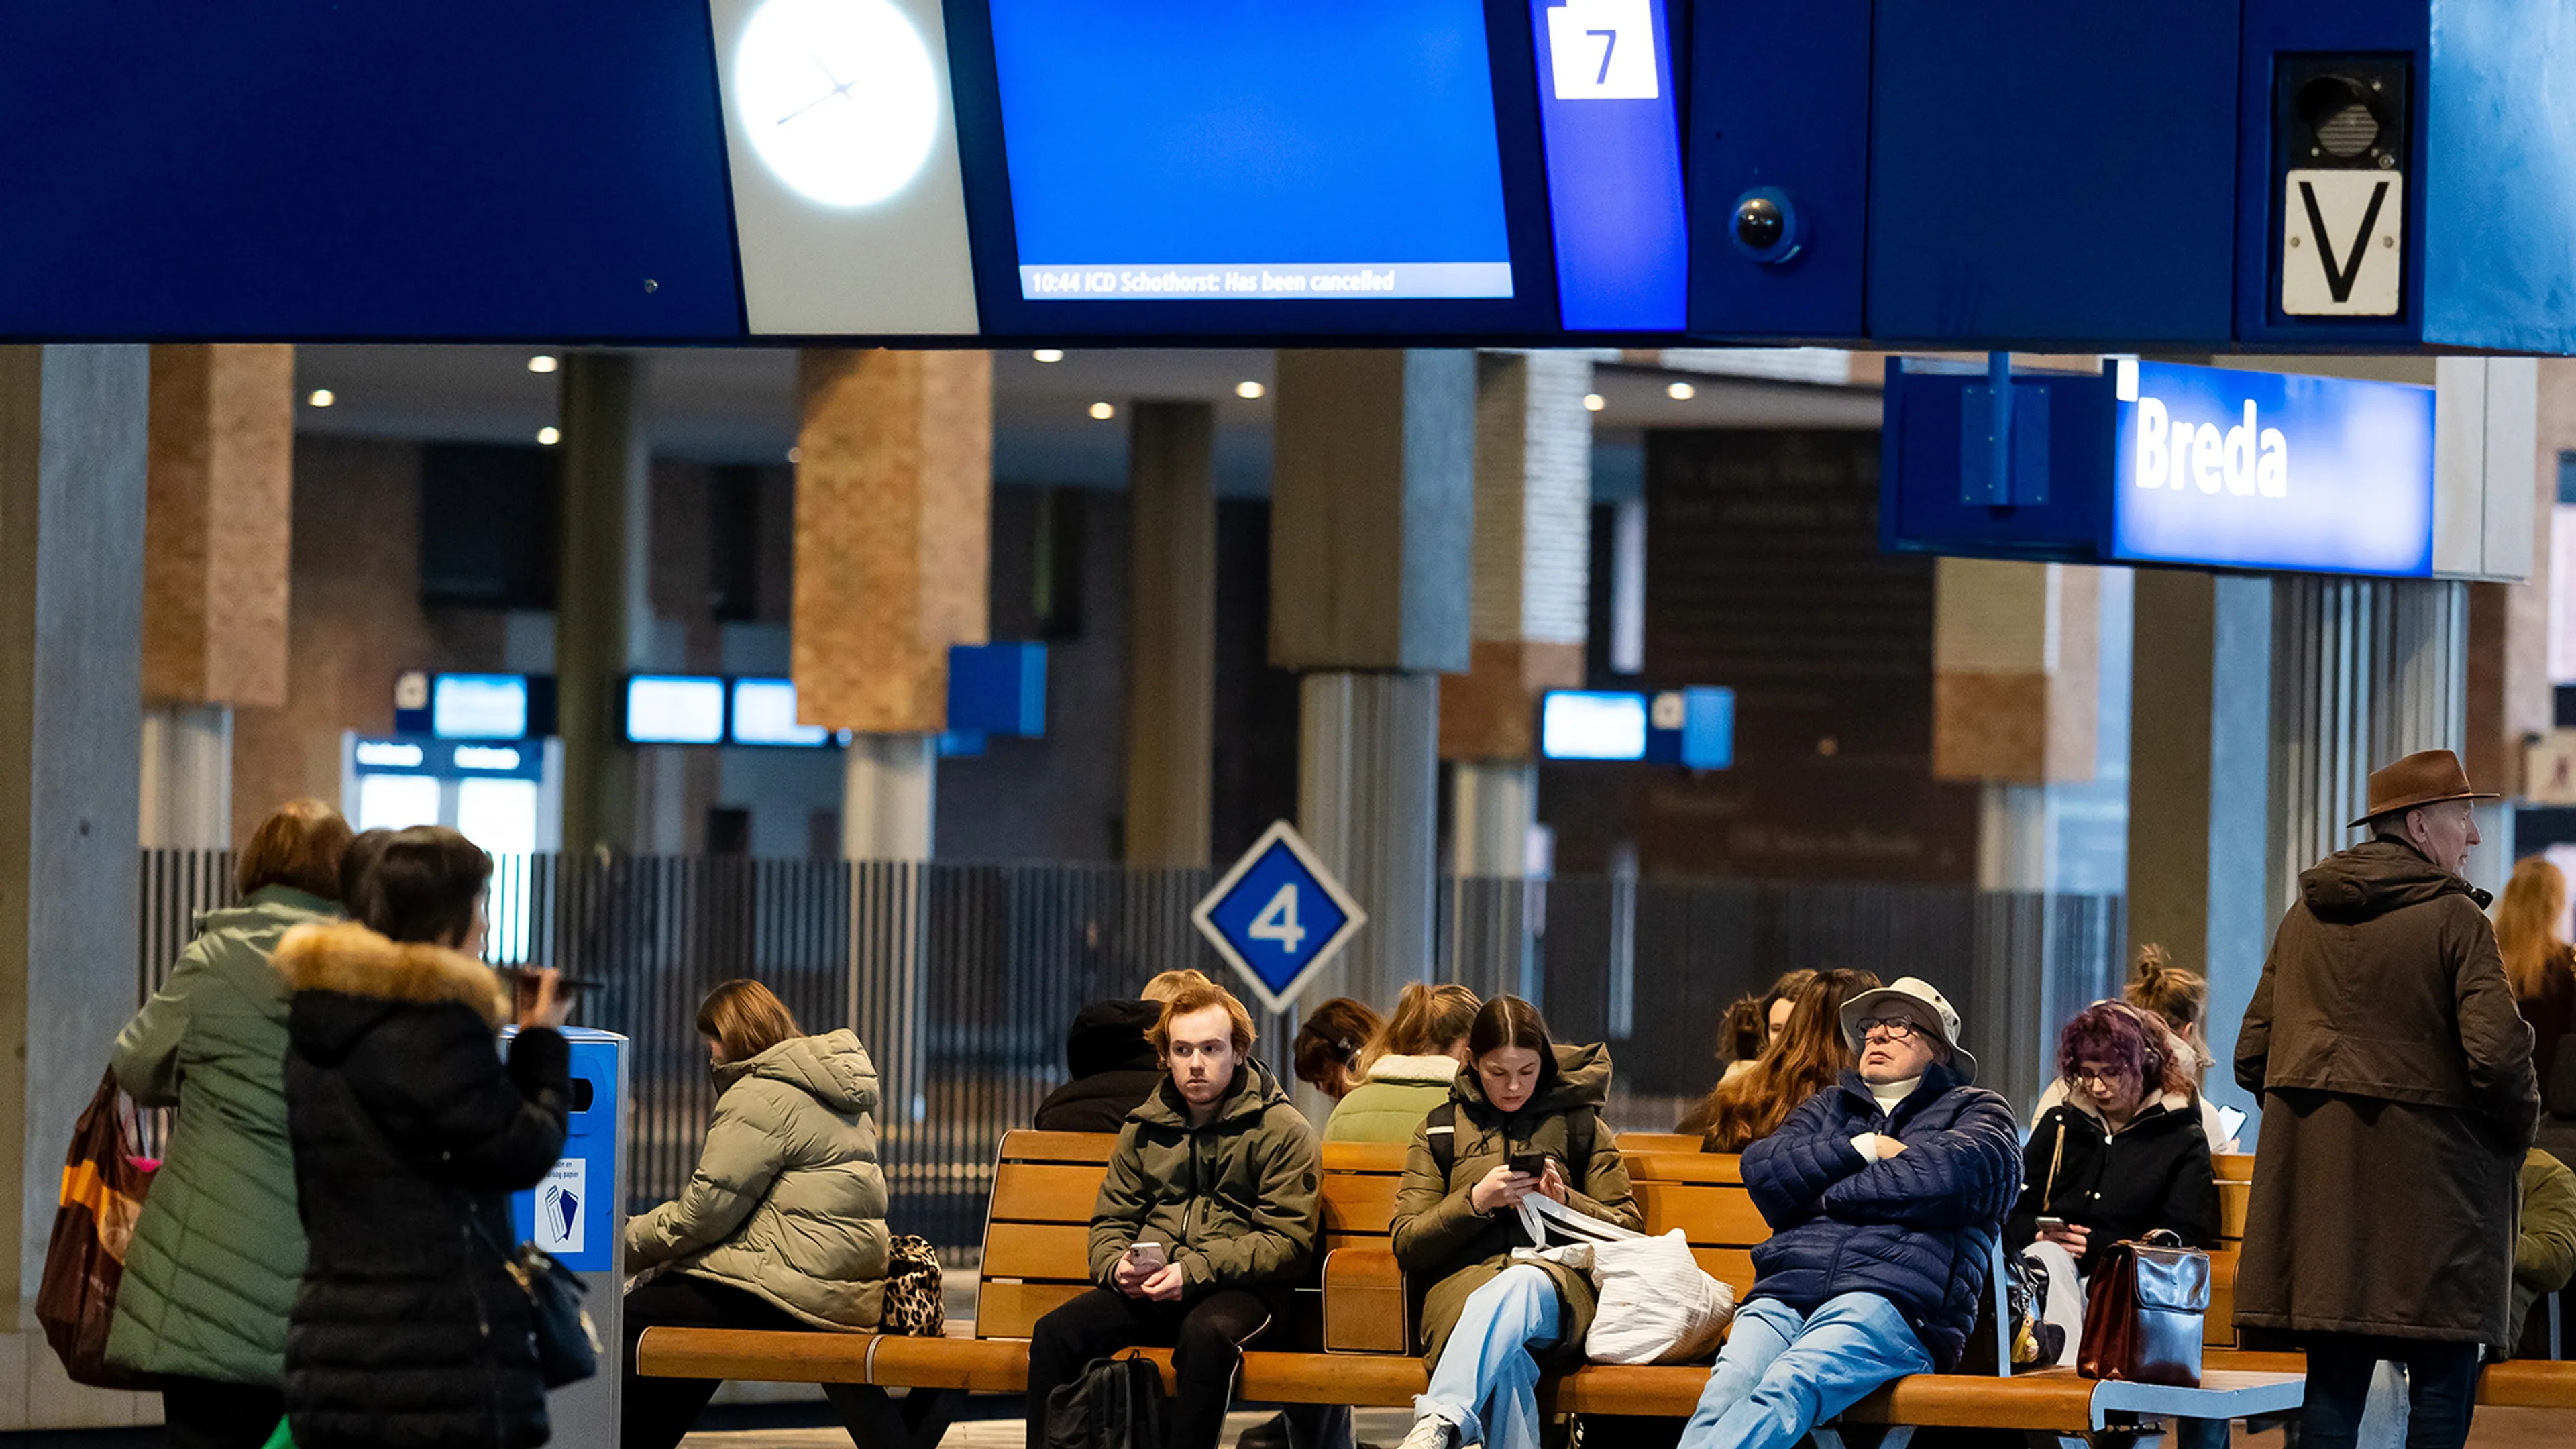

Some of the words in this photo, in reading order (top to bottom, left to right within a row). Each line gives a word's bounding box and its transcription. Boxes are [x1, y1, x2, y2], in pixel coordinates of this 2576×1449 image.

[1585, 29, 1617, 85] 7
[2298, 181, 2390, 303] V
[1033, 272, 1080, 292] 10:44
[1085, 272, 1117, 292] ICD
[1120, 271, 1220, 292] Schothorst:
[1225, 271, 1258, 292] Has
[1262, 270, 1306, 292] been
[1310, 269, 1395, 291] cancelled
[2136, 396, 2288, 498] Breda
[1248, 883, 1305, 953] 4
